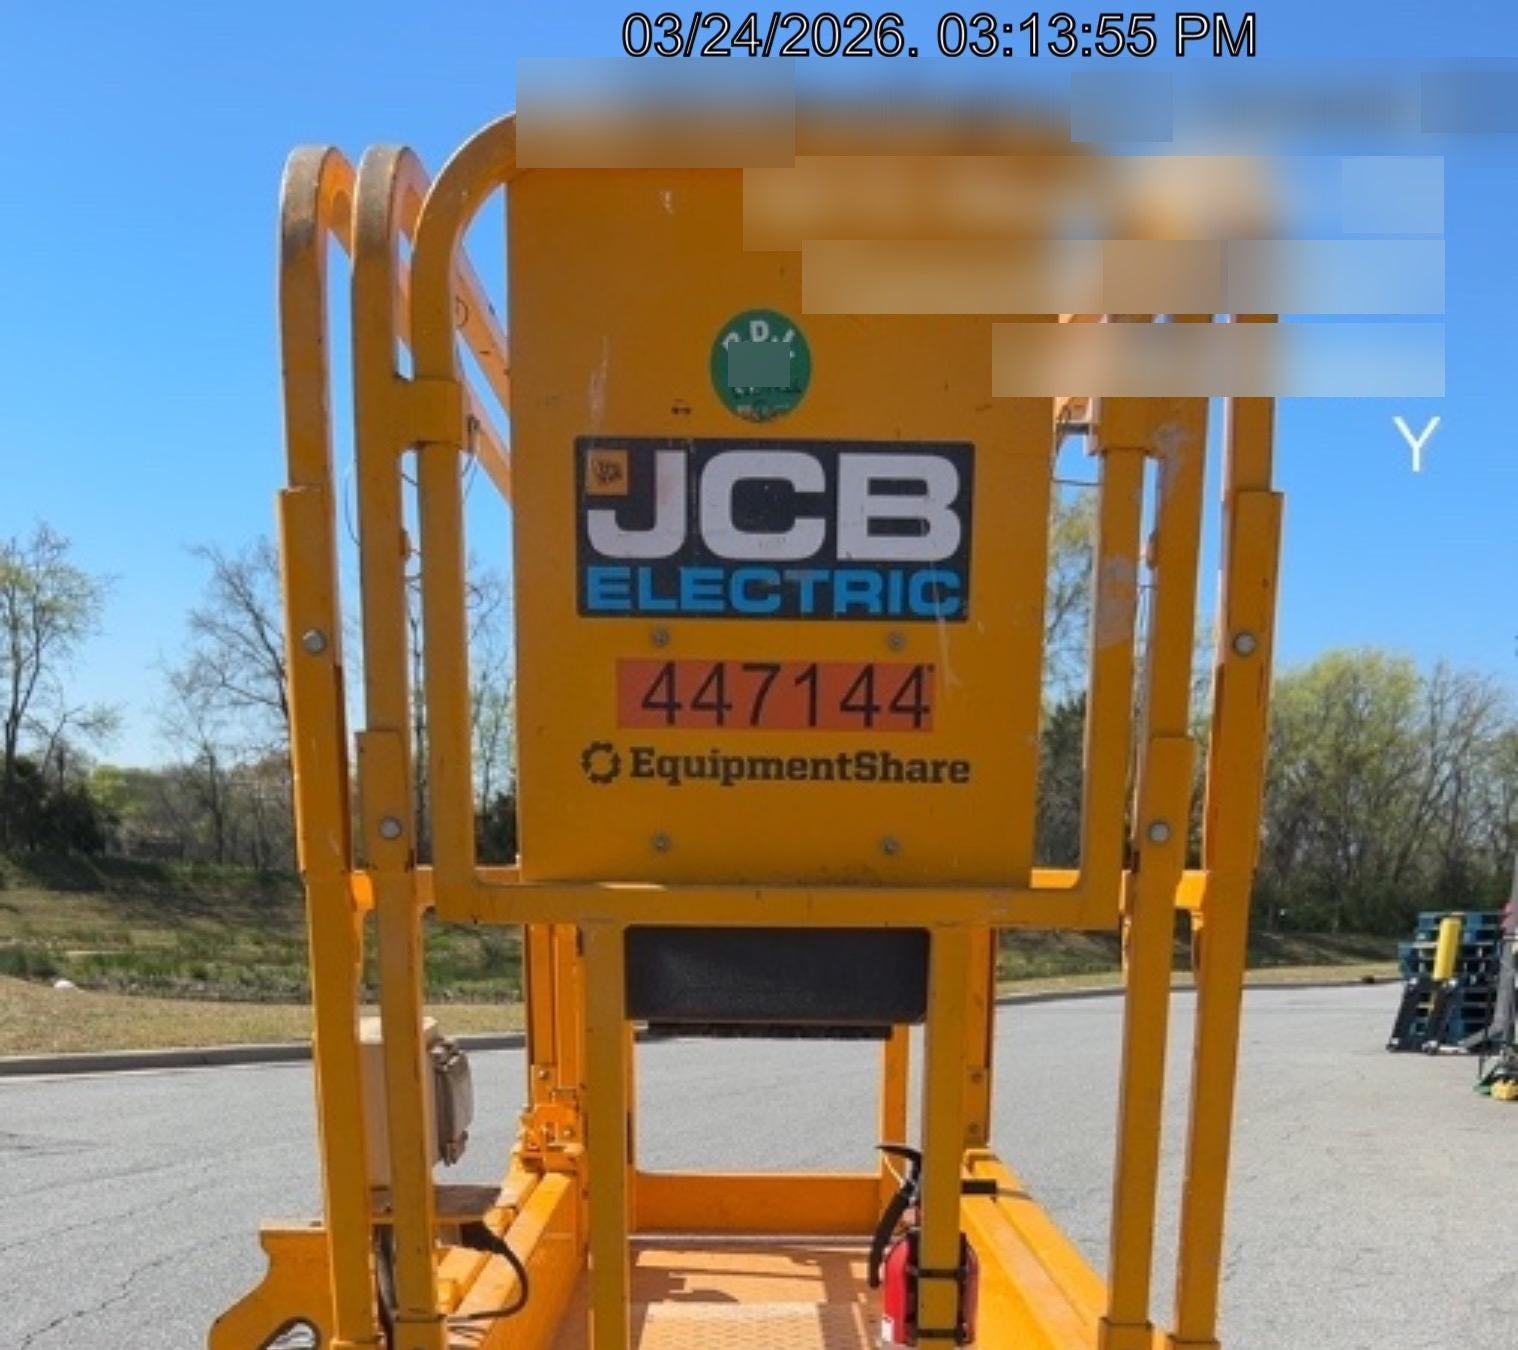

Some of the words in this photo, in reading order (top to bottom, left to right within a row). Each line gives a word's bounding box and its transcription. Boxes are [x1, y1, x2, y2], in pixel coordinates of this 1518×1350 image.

[587, 449, 961, 561] JCB
[587, 566, 960, 616] ELECTRIC
[641, 661, 931, 728] 447144
[630, 747, 970, 786] EquipmentShare
